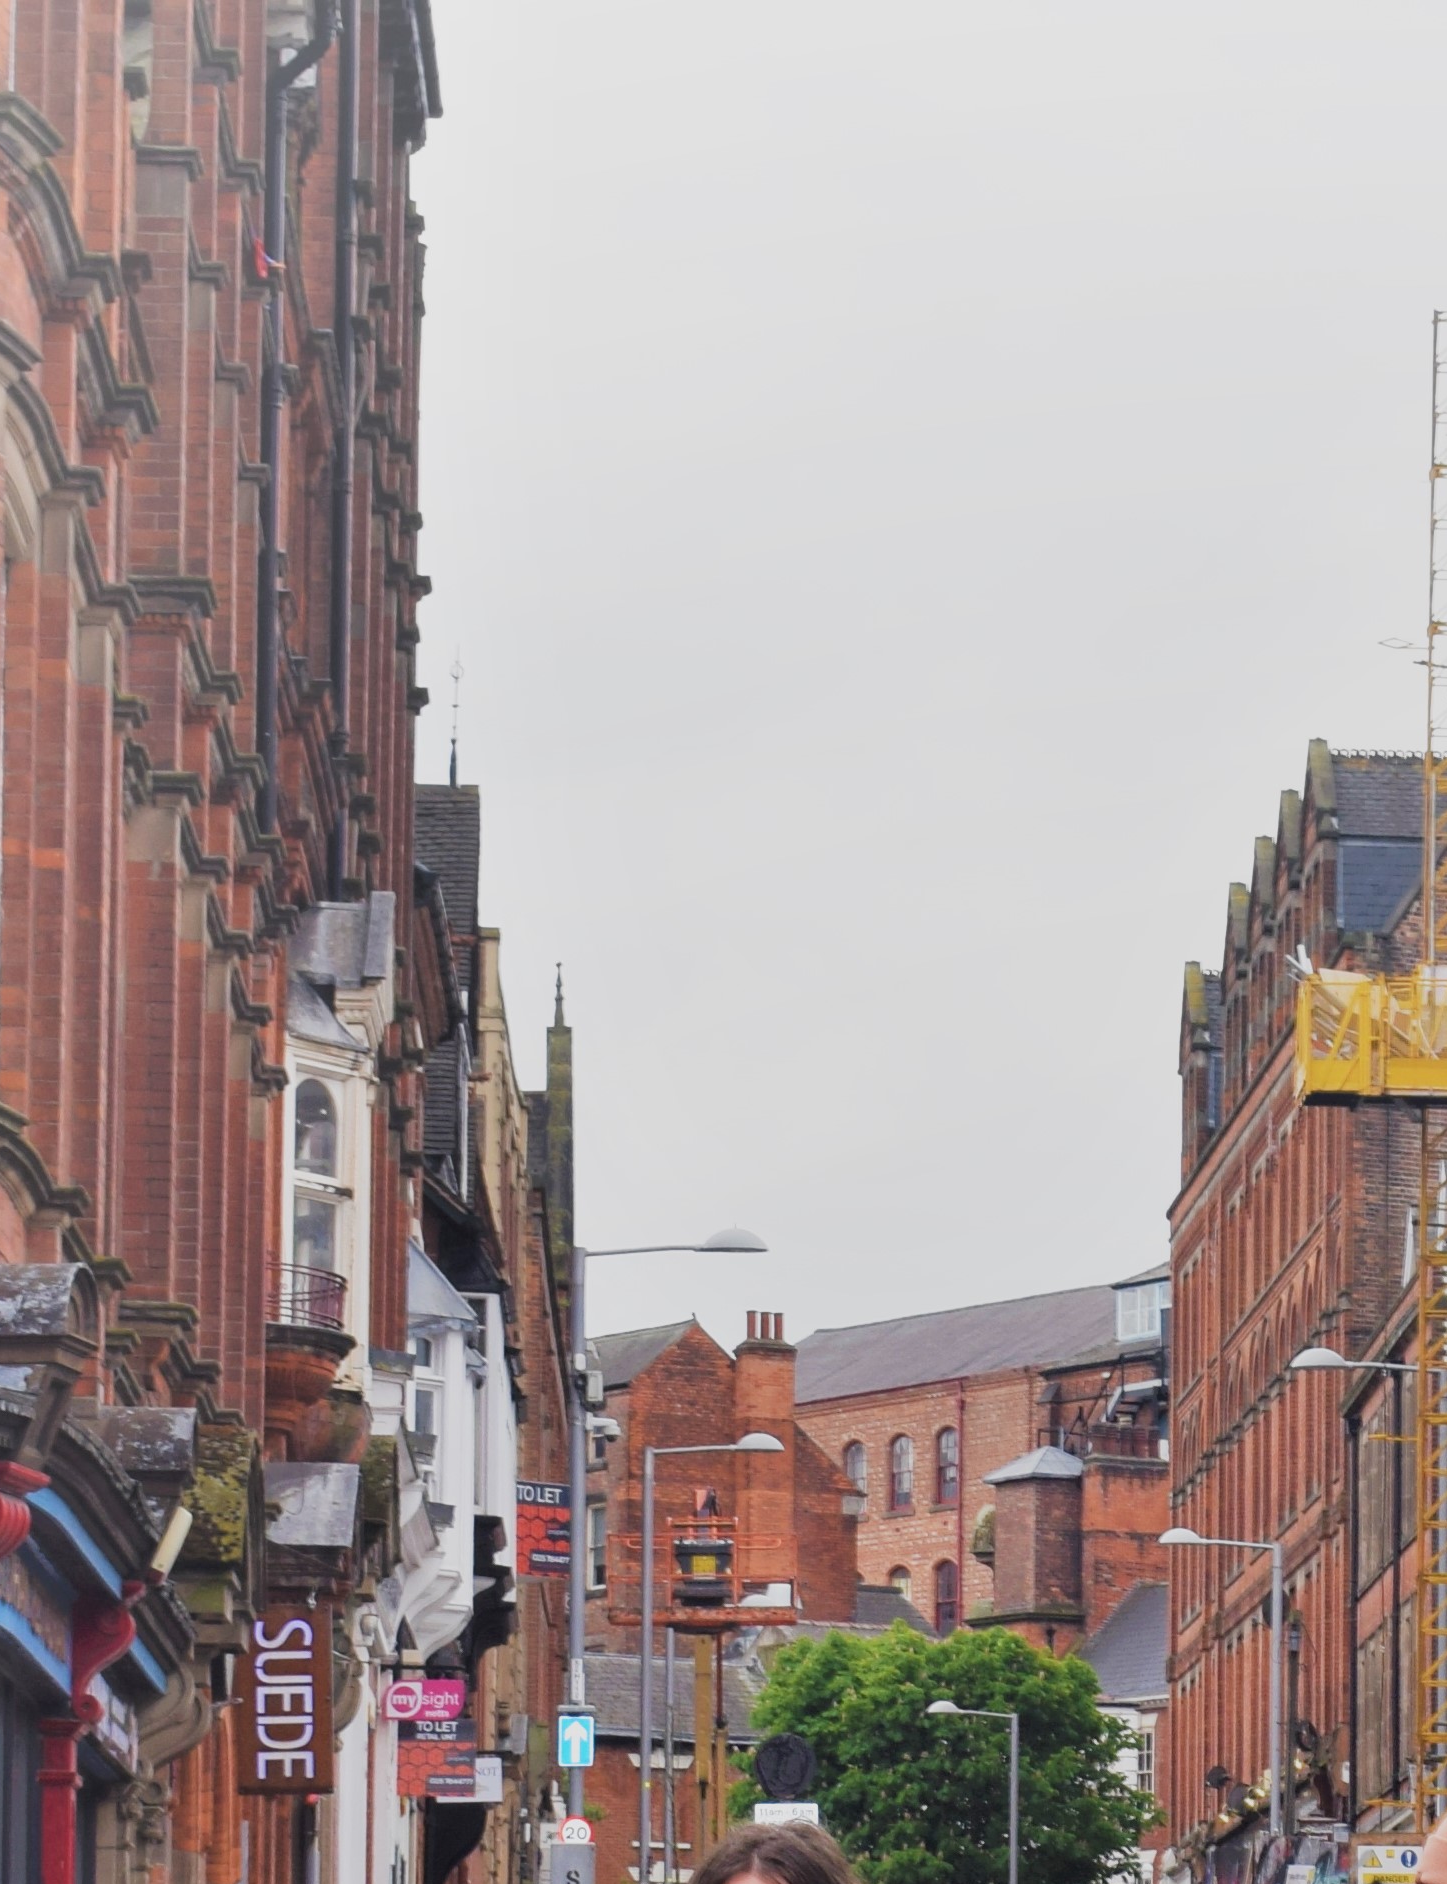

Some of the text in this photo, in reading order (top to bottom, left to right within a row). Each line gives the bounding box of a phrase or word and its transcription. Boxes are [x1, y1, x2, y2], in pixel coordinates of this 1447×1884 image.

[516, 1485, 562, 1504] TO LET
[255, 1619, 315, 1780] SUEDE
[416, 1721, 458, 1733] TO LET
[566, 1827, 587, 1840] 20
[1374, 1875, 1410, 1884] DANGER
